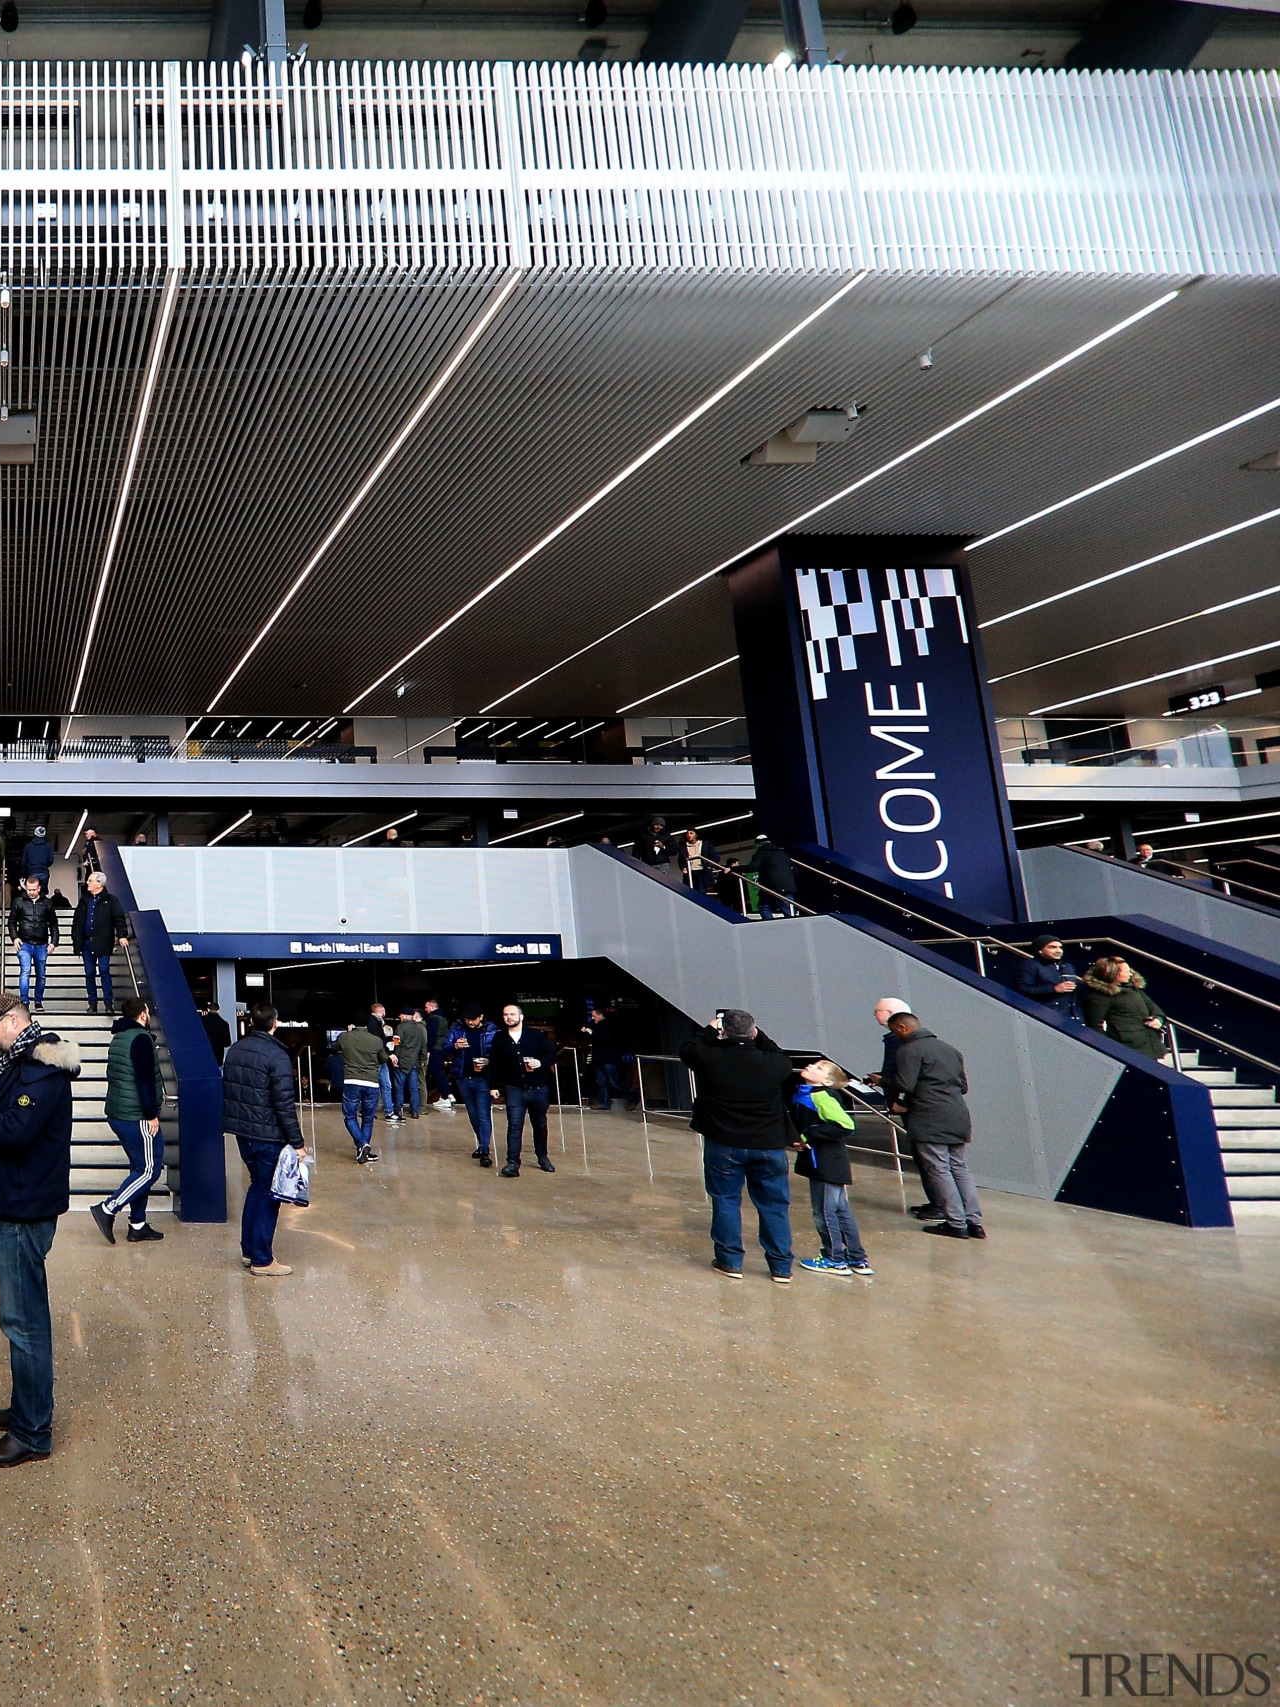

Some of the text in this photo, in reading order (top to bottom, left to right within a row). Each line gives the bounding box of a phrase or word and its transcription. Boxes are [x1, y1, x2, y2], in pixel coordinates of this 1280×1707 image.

[1188, 691, 1220, 710] 323
[864, 681, 954, 900] COME
[495, 943, 525, 954] South
